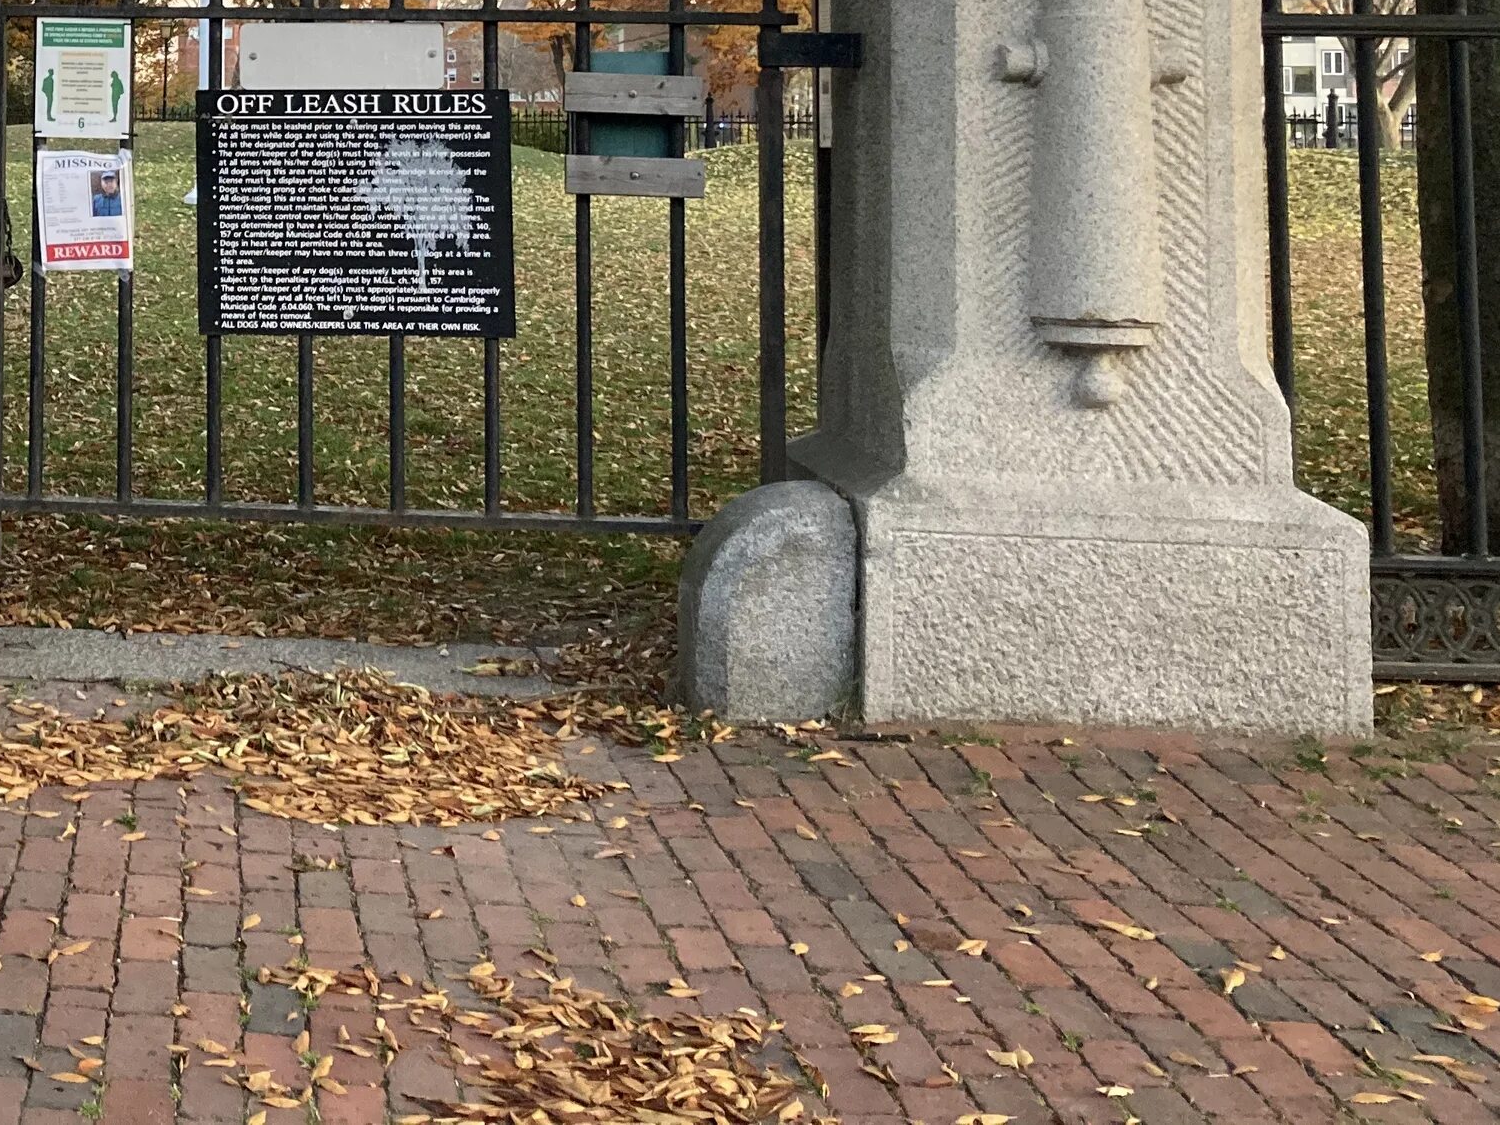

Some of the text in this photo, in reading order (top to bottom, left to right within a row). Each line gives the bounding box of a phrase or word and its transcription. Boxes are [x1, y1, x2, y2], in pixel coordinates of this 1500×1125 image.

[216, 94, 485, 114] OFF LEASH RULES
[78, 117, 84, 128] 6
[230, 123, 248, 131] dogs
[314, 123, 332, 131] prior
[345, 123, 377, 132] entering
[418, 123, 445, 132] leaving
[284, 132, 302, 141] dogs
[319, 132, 339, 141] using
[254, 141, 295, 150] designated
[335, 141, 361, 150] his/her
[55, 158, 112, 169] MISSING
[219, 240, 239, 248] Dogs
[300, 240, 338, 249] permitted
[54, 244, 122, 258] REWARD
[220, 294, 248, 302] dispose
[342, 295, 352, 303] by
[369, 295, 394, 304] dog(s)
[396, 295, 430, 304] pursuant
[444, 296, 485, 304] Cambridge
